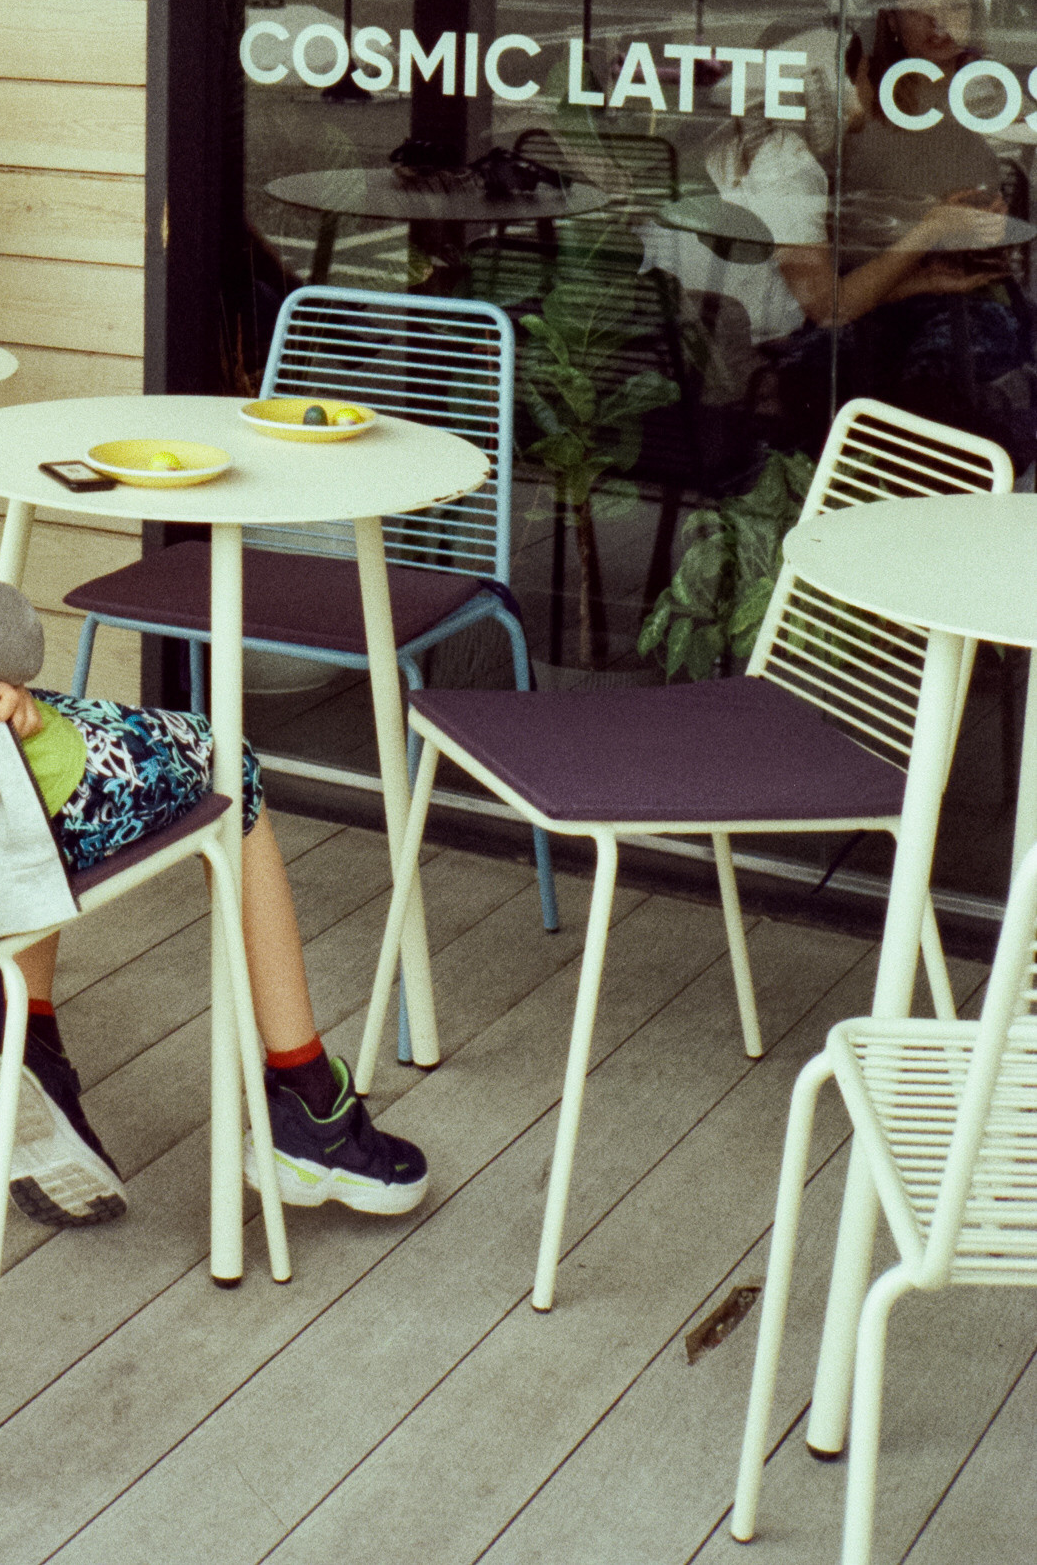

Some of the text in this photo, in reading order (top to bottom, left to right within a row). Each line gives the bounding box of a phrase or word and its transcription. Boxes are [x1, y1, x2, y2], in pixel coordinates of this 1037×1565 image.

[239, 20, 808, 121] COSMIC LATTE
[878, 57, 1037, 134] CO
